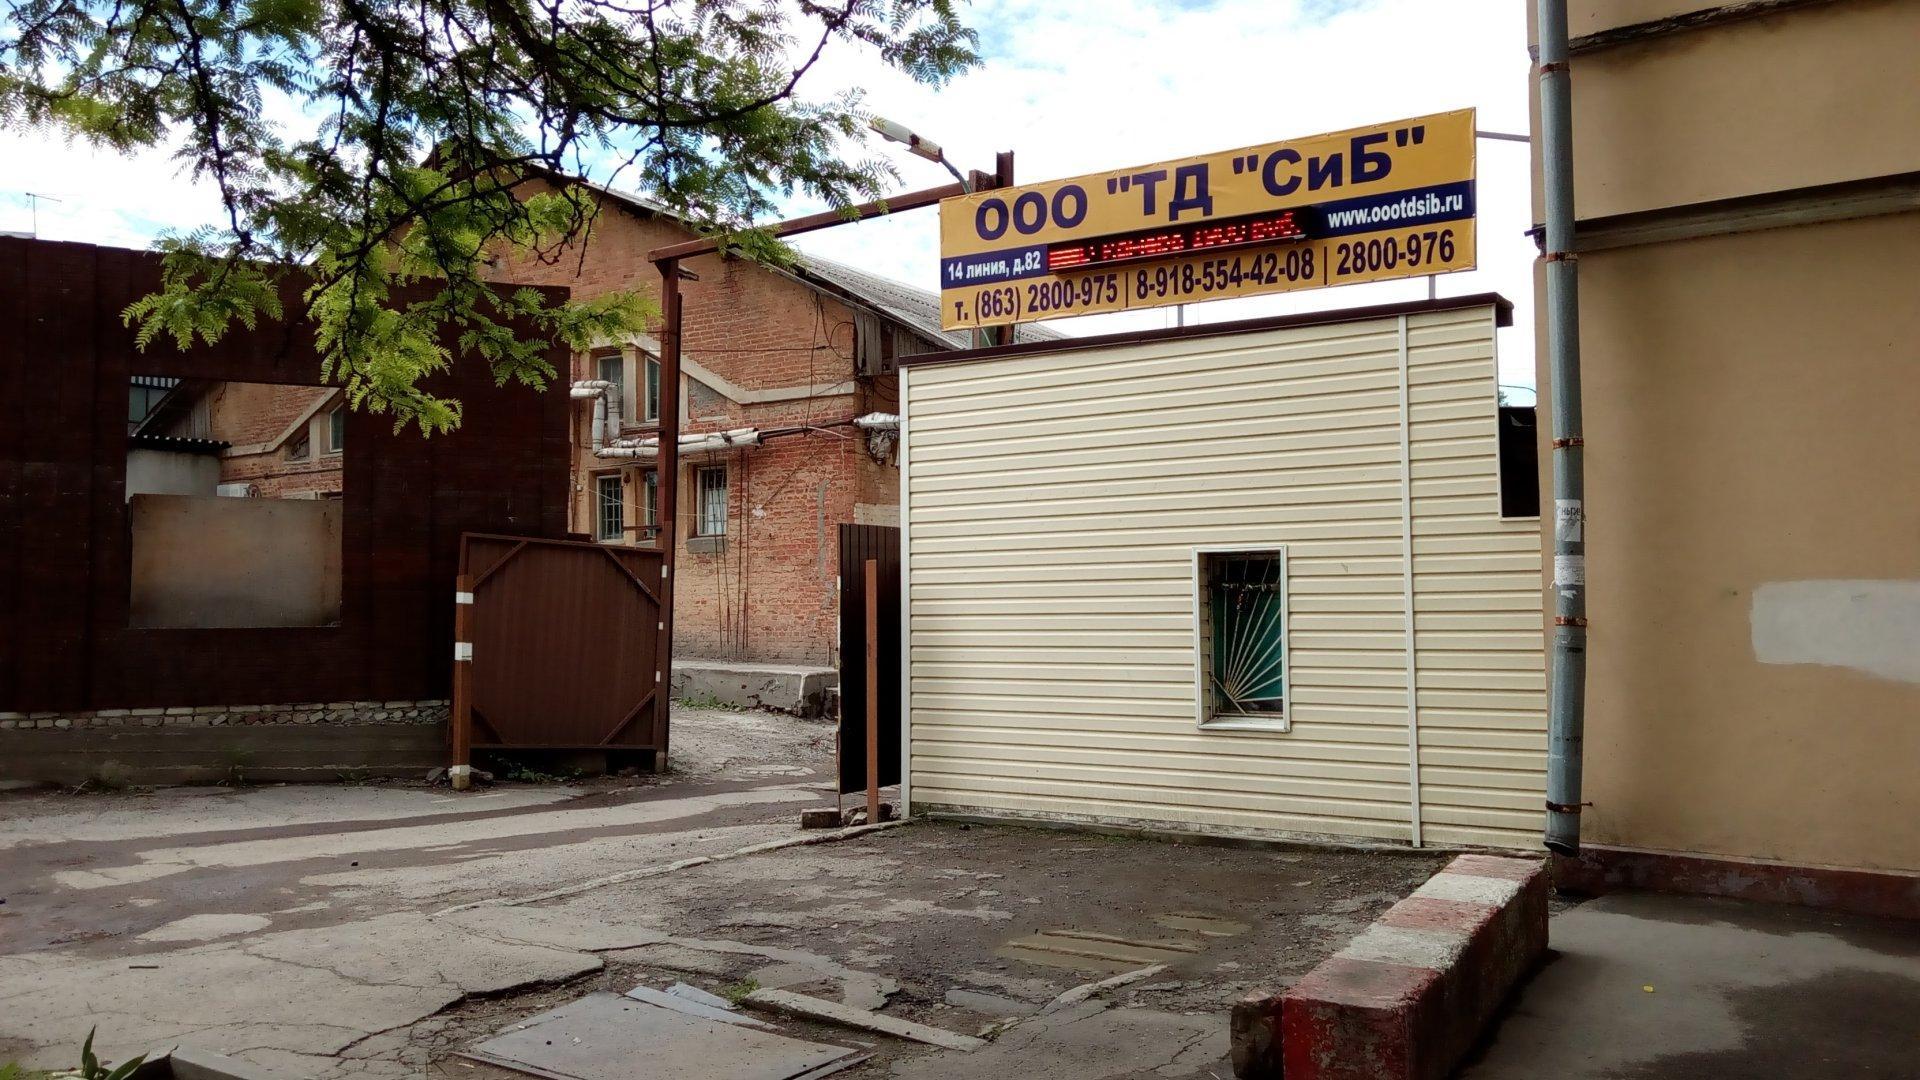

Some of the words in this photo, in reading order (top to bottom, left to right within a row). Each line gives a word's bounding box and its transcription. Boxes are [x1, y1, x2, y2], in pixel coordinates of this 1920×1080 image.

[975, 185, 1088, 241] ООО
[1106, 163, 1213, 221] "ТД
[1232, 125, 1425, 197] "СиБ"
[1327, 193, 1463, 229] www.oootdsib.ru
[948, 262, 963, 281] 14
[966, 259, 1010, 279] линия,
[1013, 251, 1041, 275] д.82
[954, 301, 969, 321] т.
[975, 286, 1021, 325] (863)
[1027, 274, 1118, 313] 2800-975
[1136, 248, 1314, 300] 8-918-554-42-08
[1336, 229, 1455, 276] 2800-976
